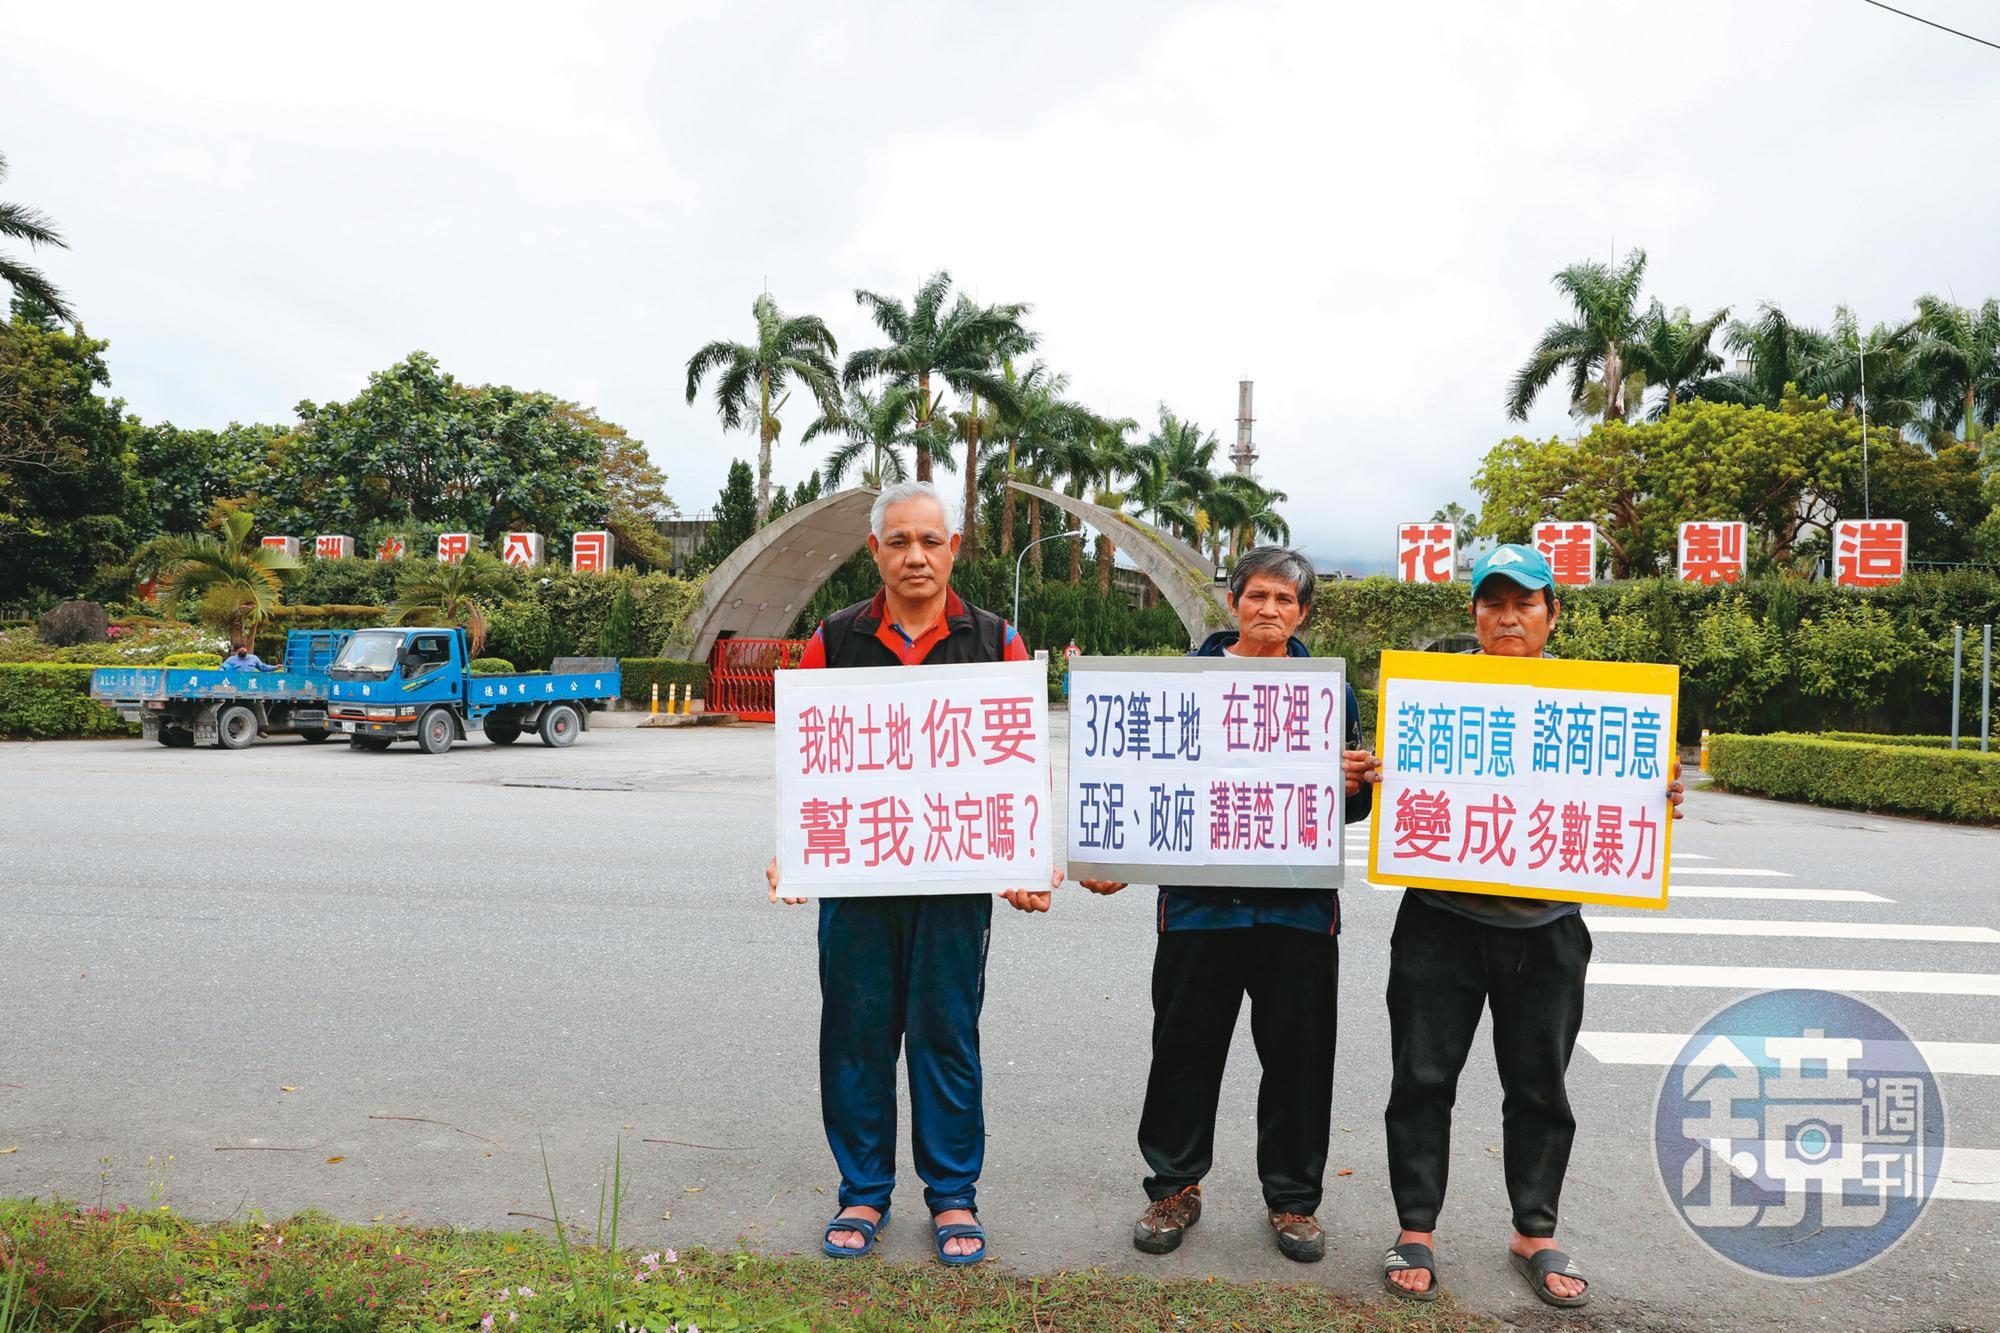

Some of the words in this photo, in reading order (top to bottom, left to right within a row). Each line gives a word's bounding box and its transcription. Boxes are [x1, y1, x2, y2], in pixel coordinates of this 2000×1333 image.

[1400, 522, 1904, 588] 花蓮製造
[1396, 701, 1517, 778] 諮商同意
[1532, 699, 1662, 780] 諮商同意
